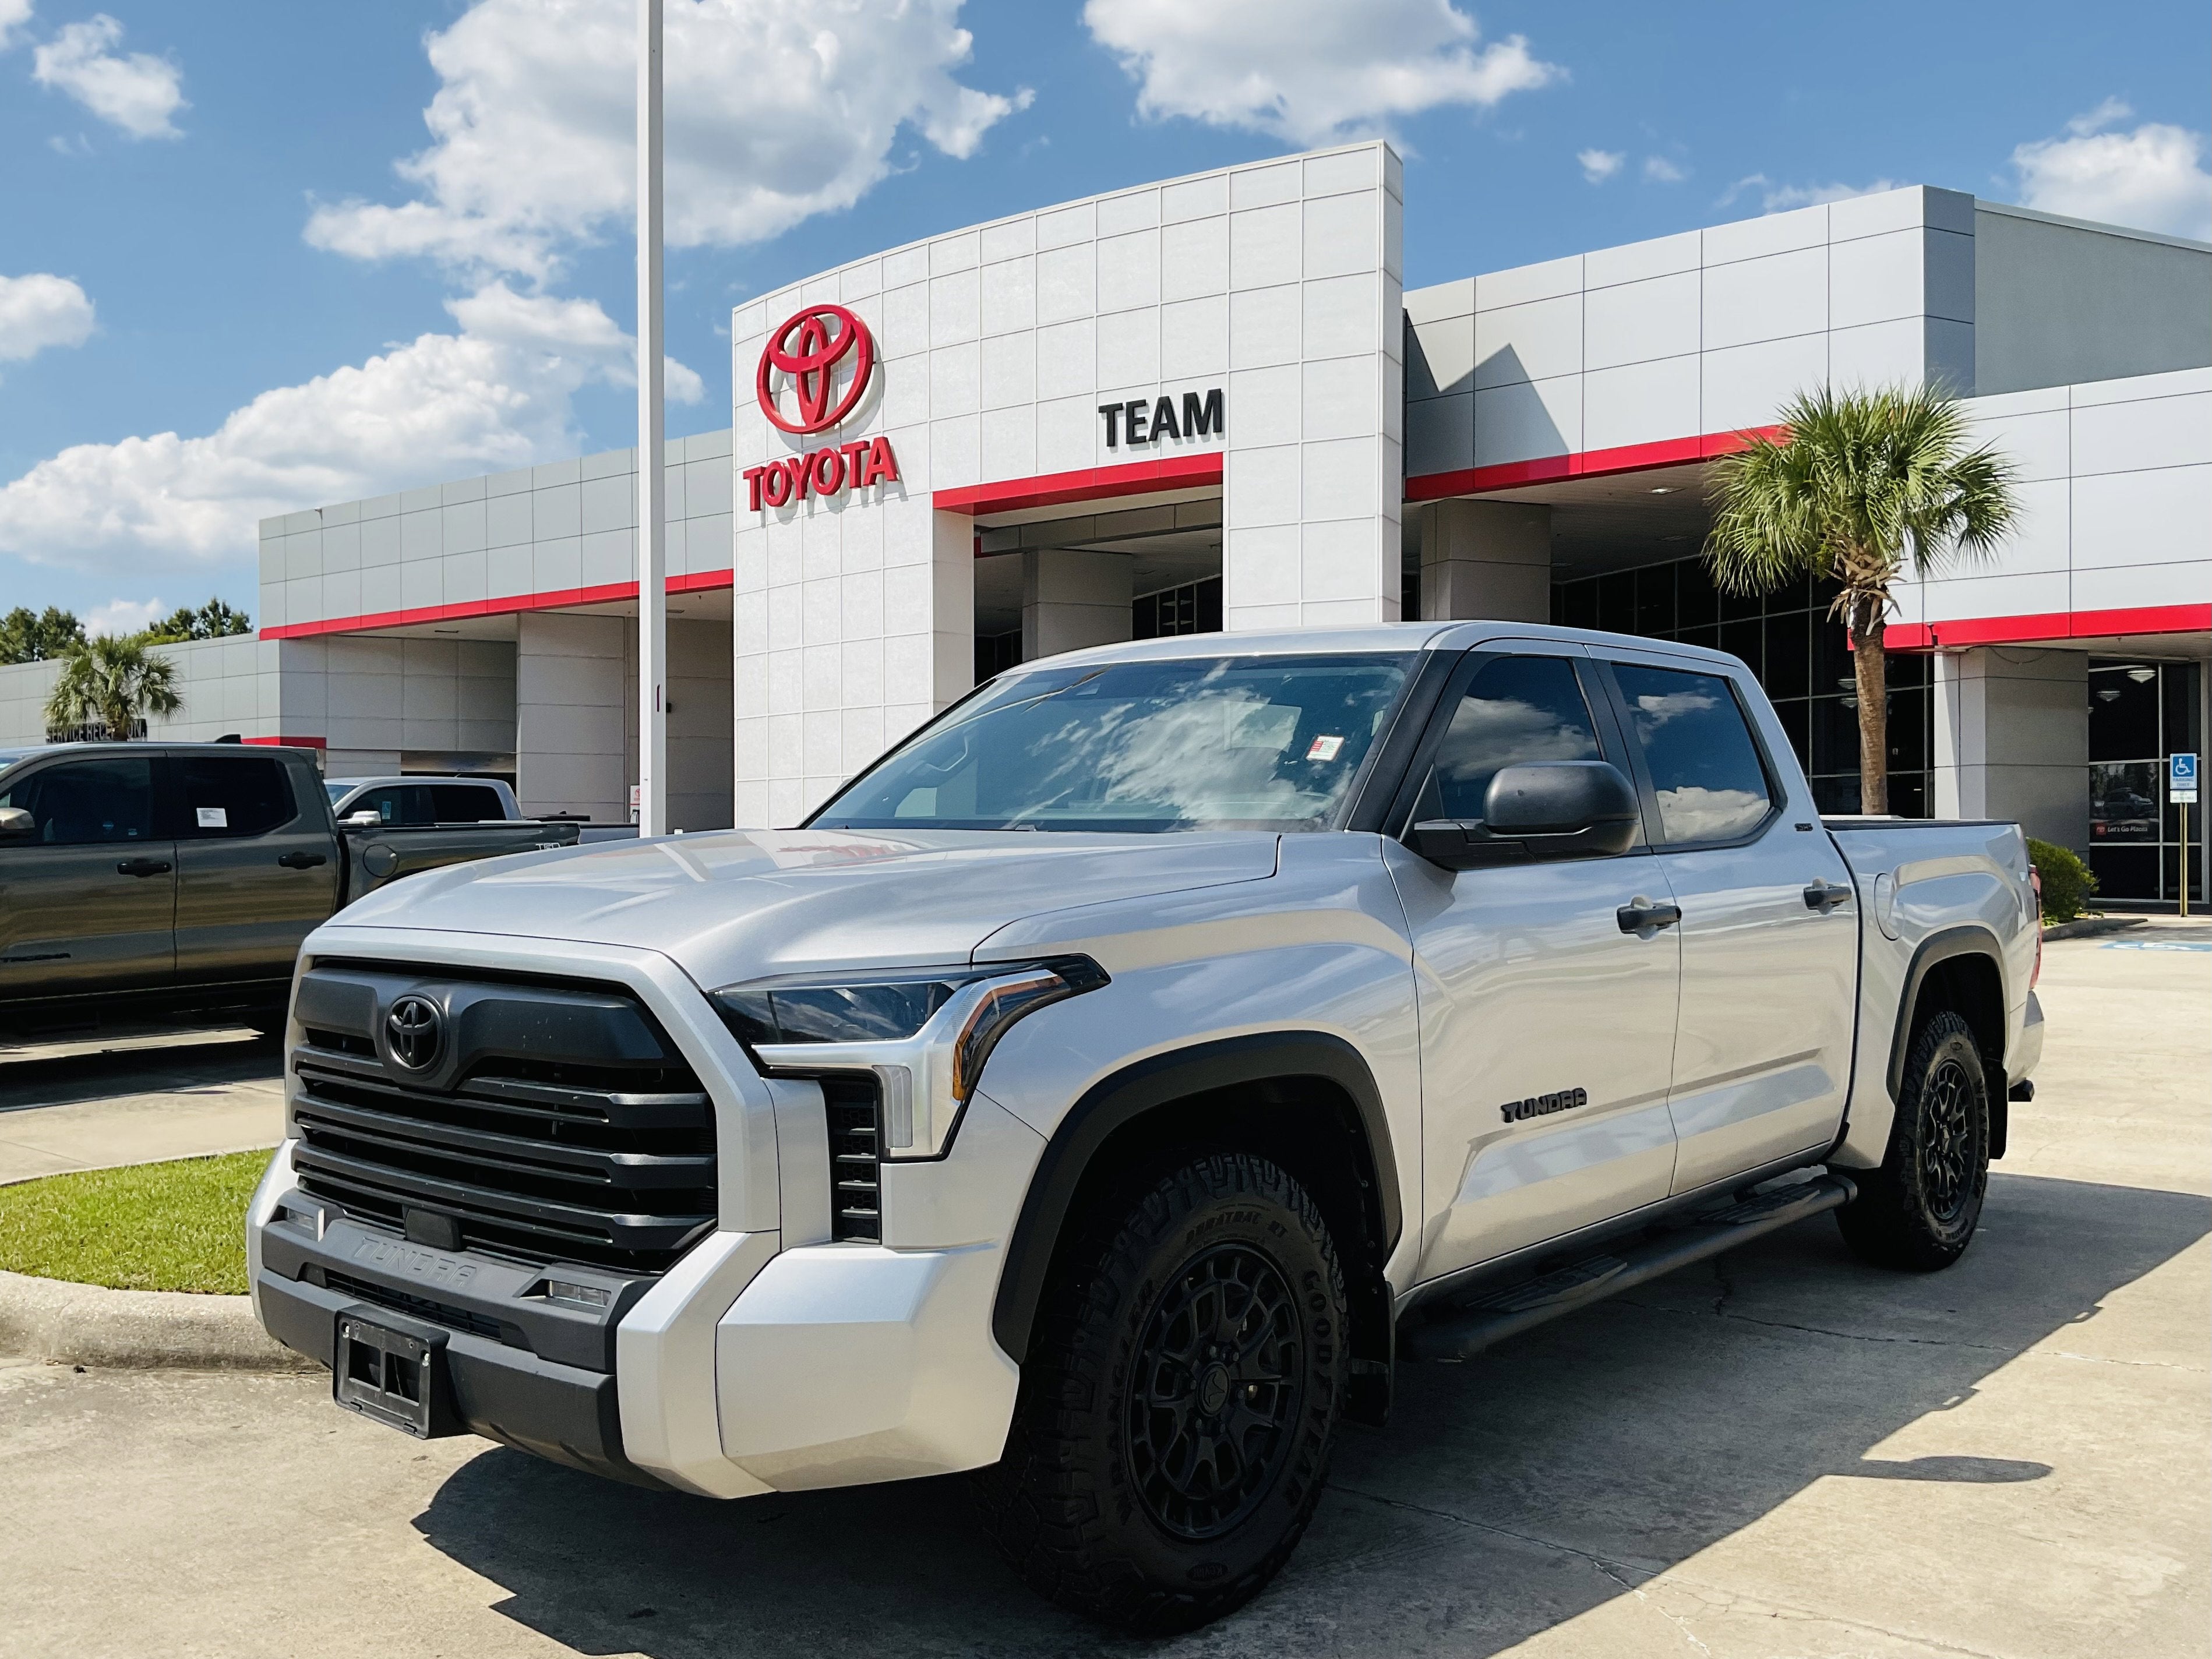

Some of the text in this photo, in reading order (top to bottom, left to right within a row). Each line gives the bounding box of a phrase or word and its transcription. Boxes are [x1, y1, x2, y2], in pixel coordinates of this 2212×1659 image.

[1098, 389, 1222, 447] TEAM
[743, 436, 899, 512] TOYOTA
[535, 842, 560, 850] TRD
[1501, 1088, 1587, 1123] TUNDRA
[354, 1237, 477, 1287] TUNDRA
